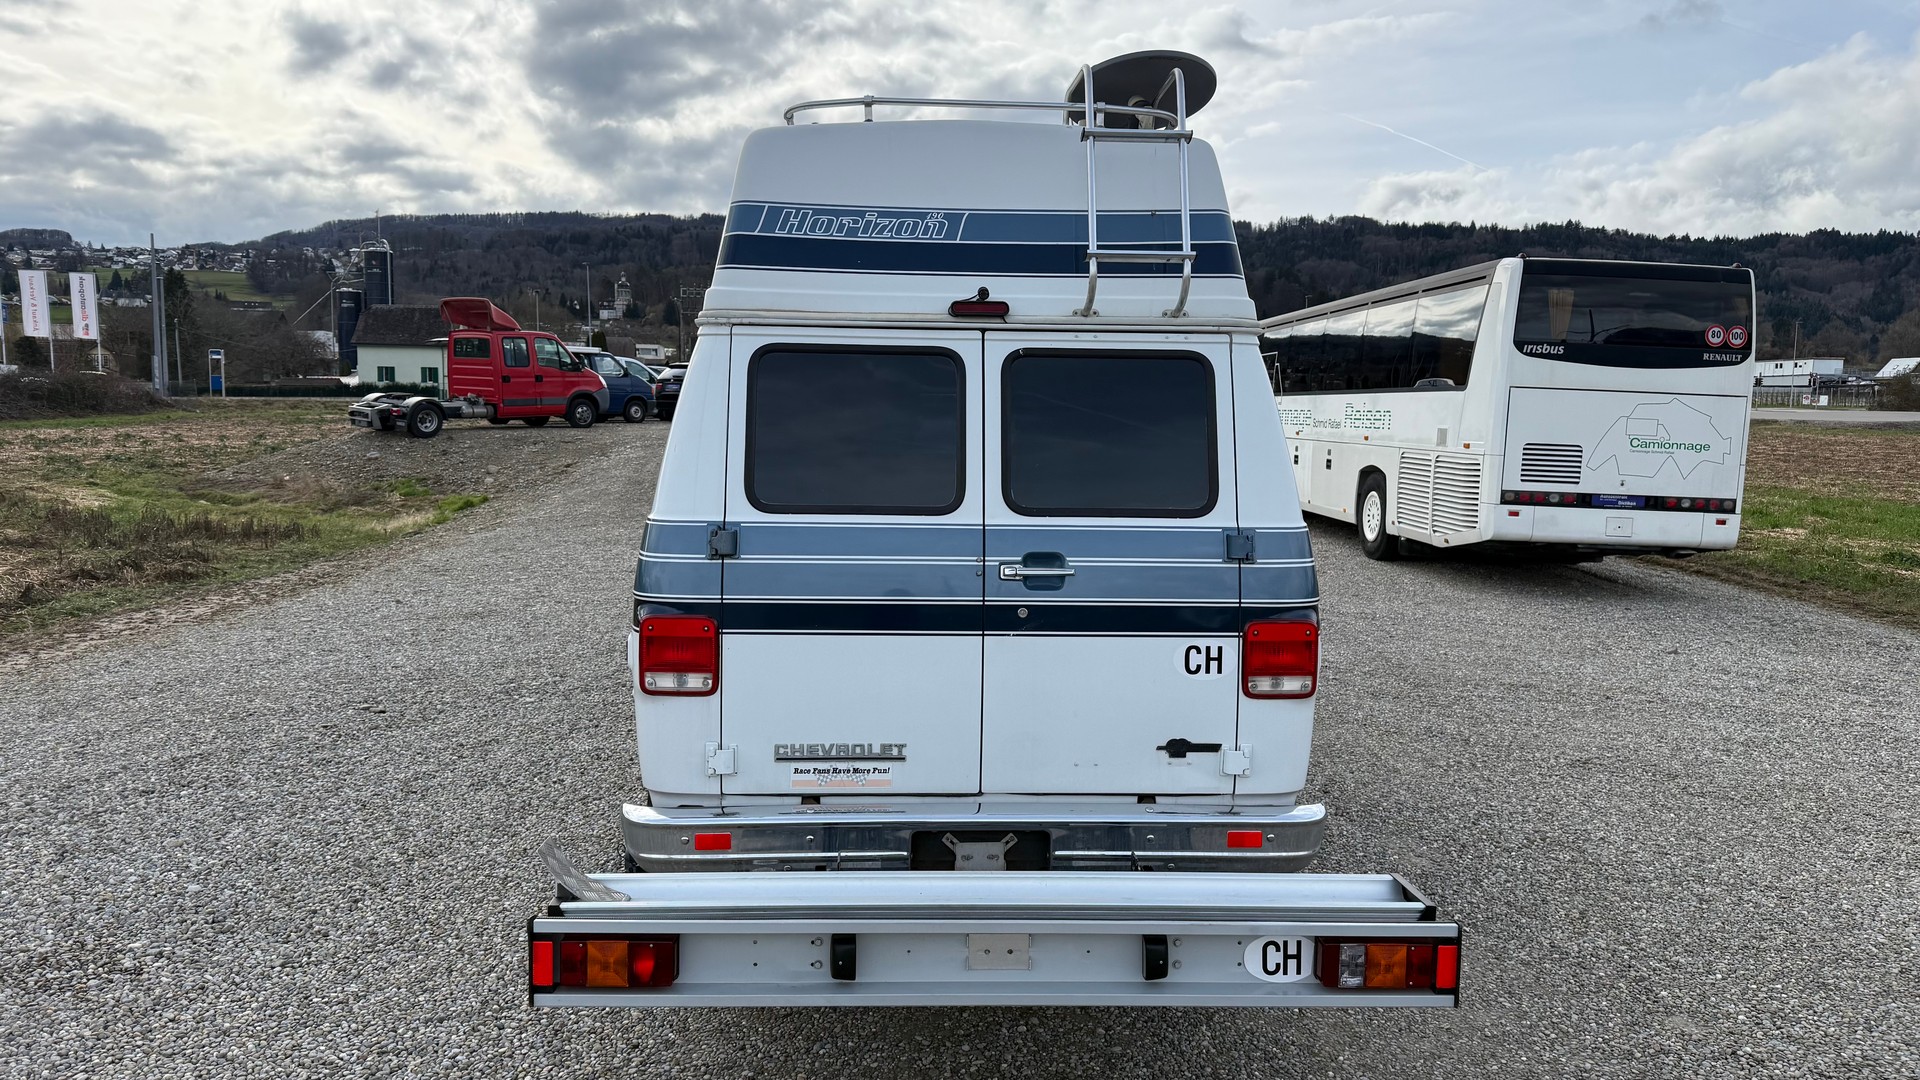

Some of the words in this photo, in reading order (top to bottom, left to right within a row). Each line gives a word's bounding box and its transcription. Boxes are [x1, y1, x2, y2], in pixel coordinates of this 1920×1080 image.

[775, 209, 948, 238] Horizon
[1711, 330, 1722, 339] 80
[1731, 331, 1744, 341] 100
[1522, 343, 1565, 355] irisbus
[1702, 352, 1742, 362] RENAULT
[1343, 402, 1392, 430] Reisen
[1629, 437, 1711, 454] Camionnage
[1184, 645, 1223, 675] CH
[774, 743, 907, 757] CHEVROLET
[793, 767, 811, 775] Race
[812, 767, 830, 775] Fans
[831, 767, 851, 775] Have
[852, 767, 871, 775] More
[1262, 940, 1302, 976] CH
